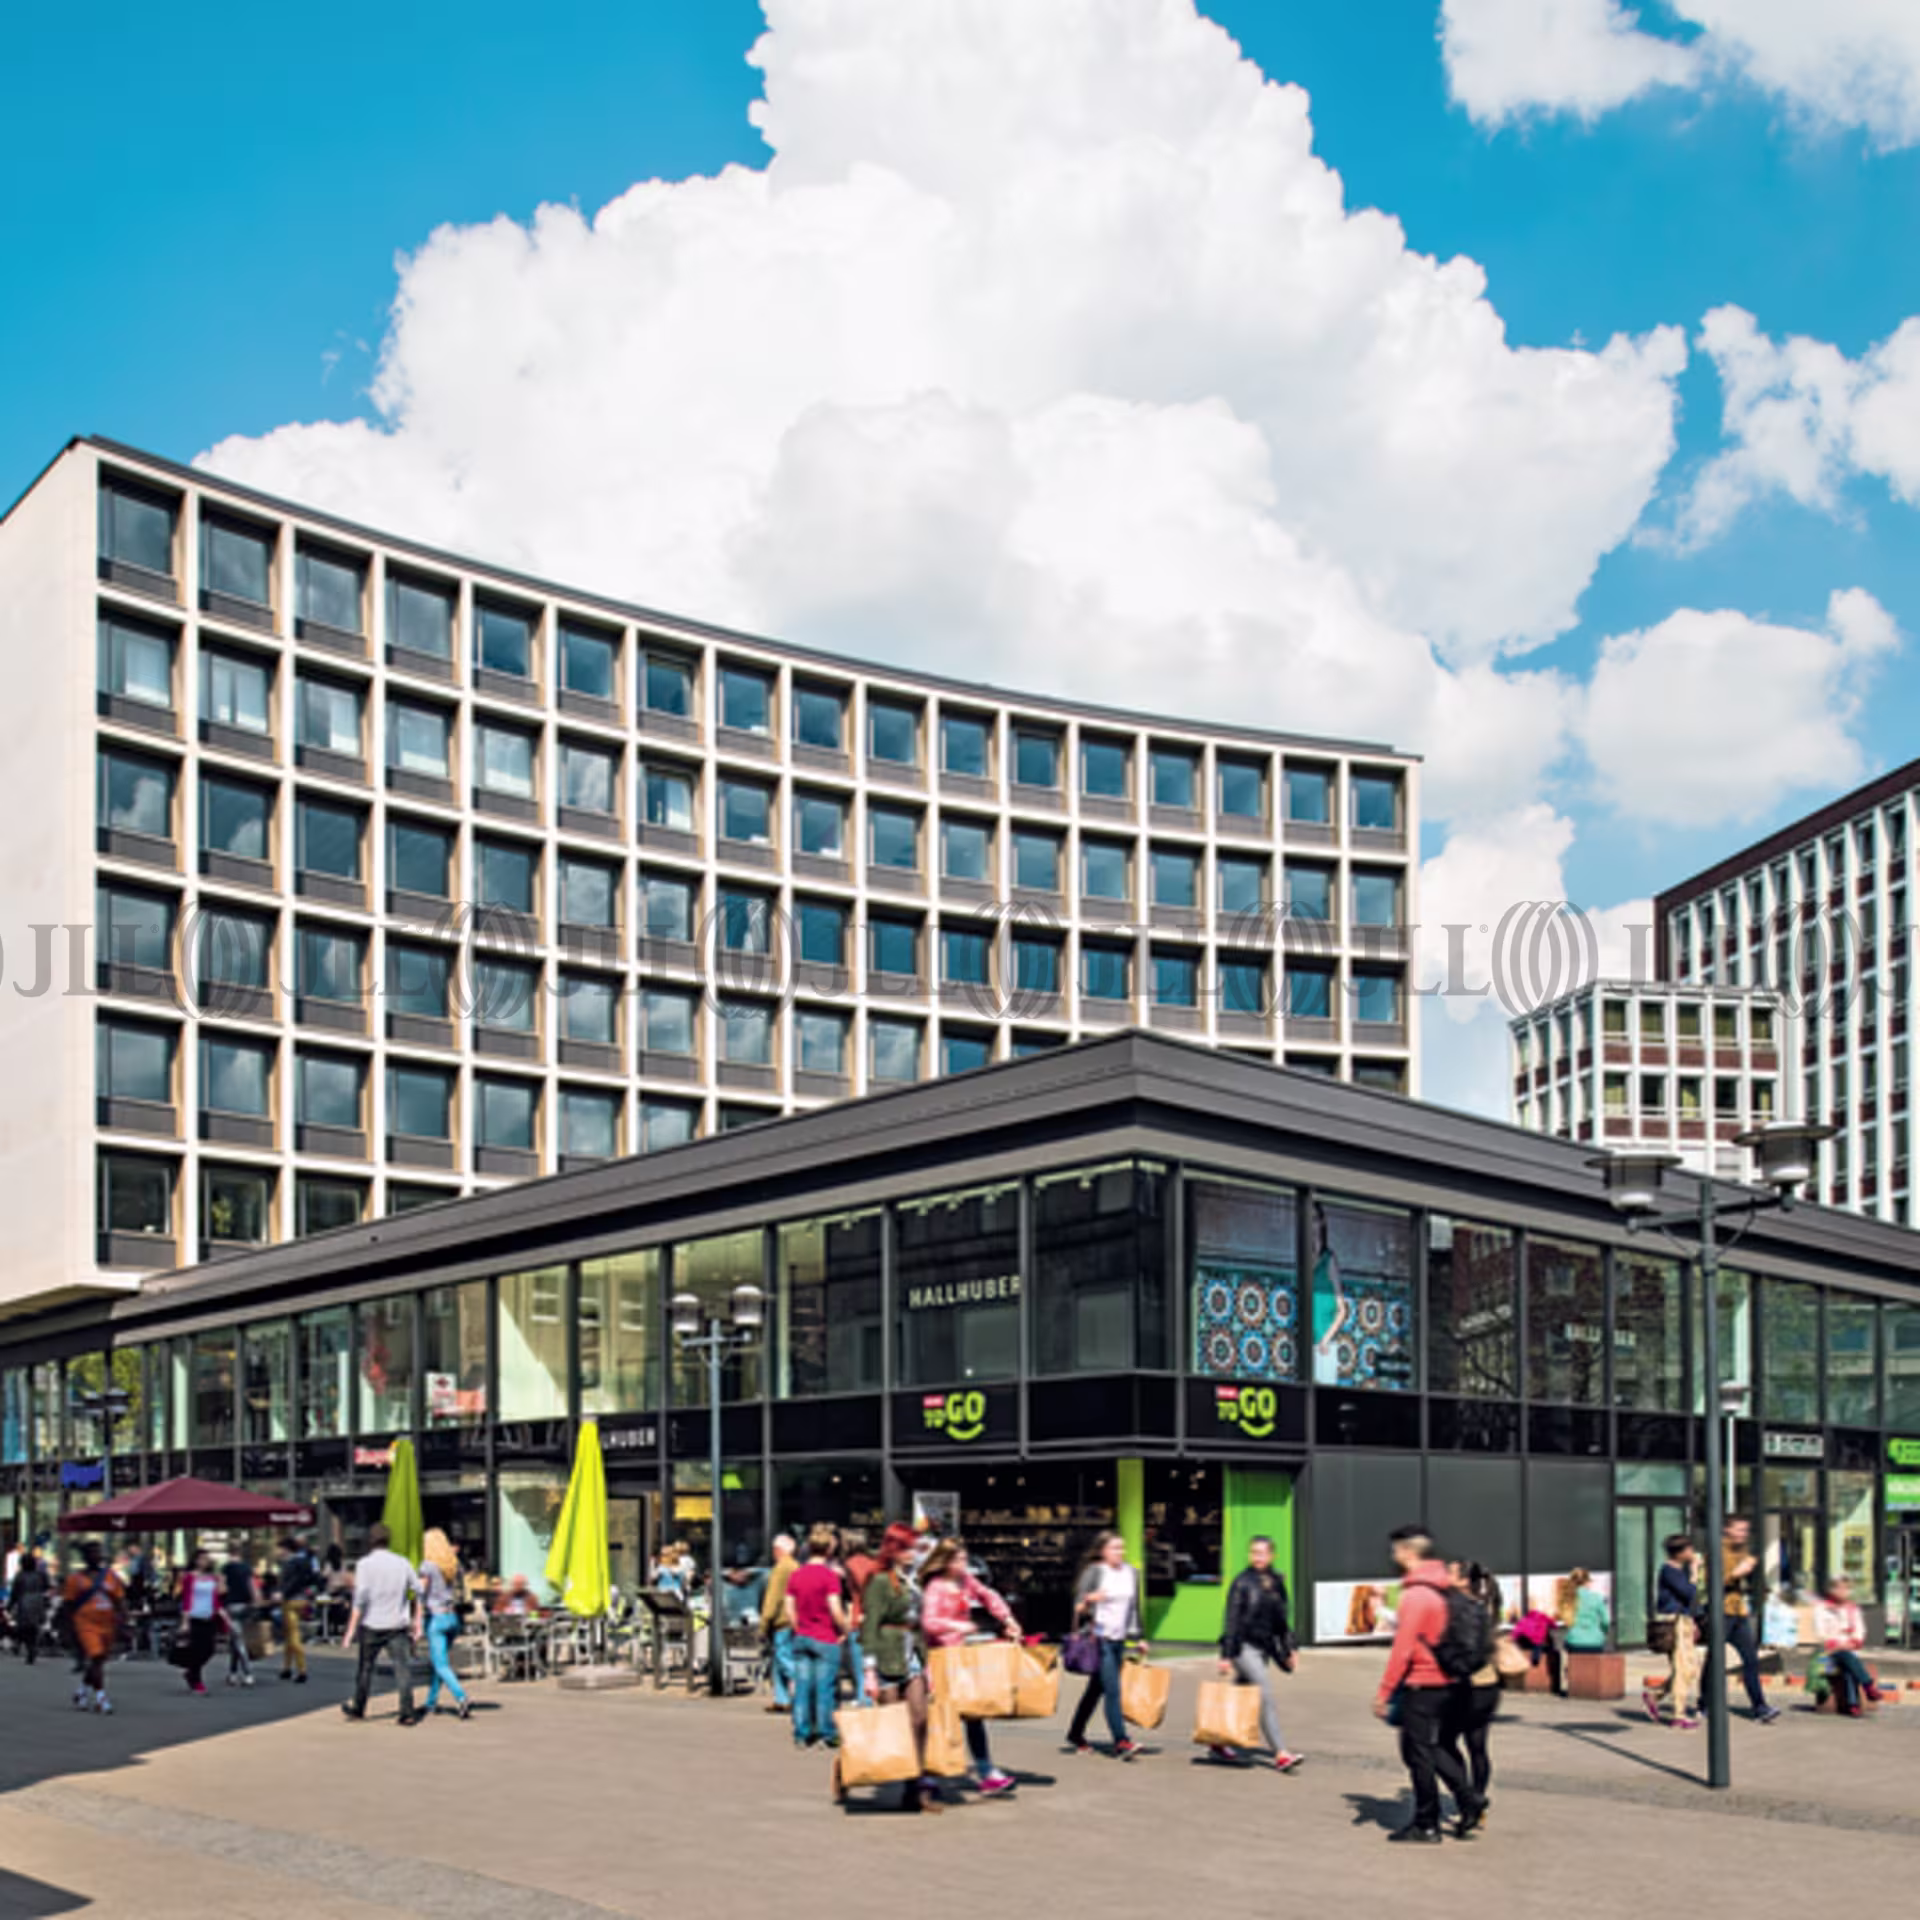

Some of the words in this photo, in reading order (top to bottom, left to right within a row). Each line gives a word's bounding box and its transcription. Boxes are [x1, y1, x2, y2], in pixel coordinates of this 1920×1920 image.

[909, 1275, 1021, 1308] HALLHUBER
[946, 1391, 986, 1422] GO
[1239, 1386, 1276, 1419] GO
